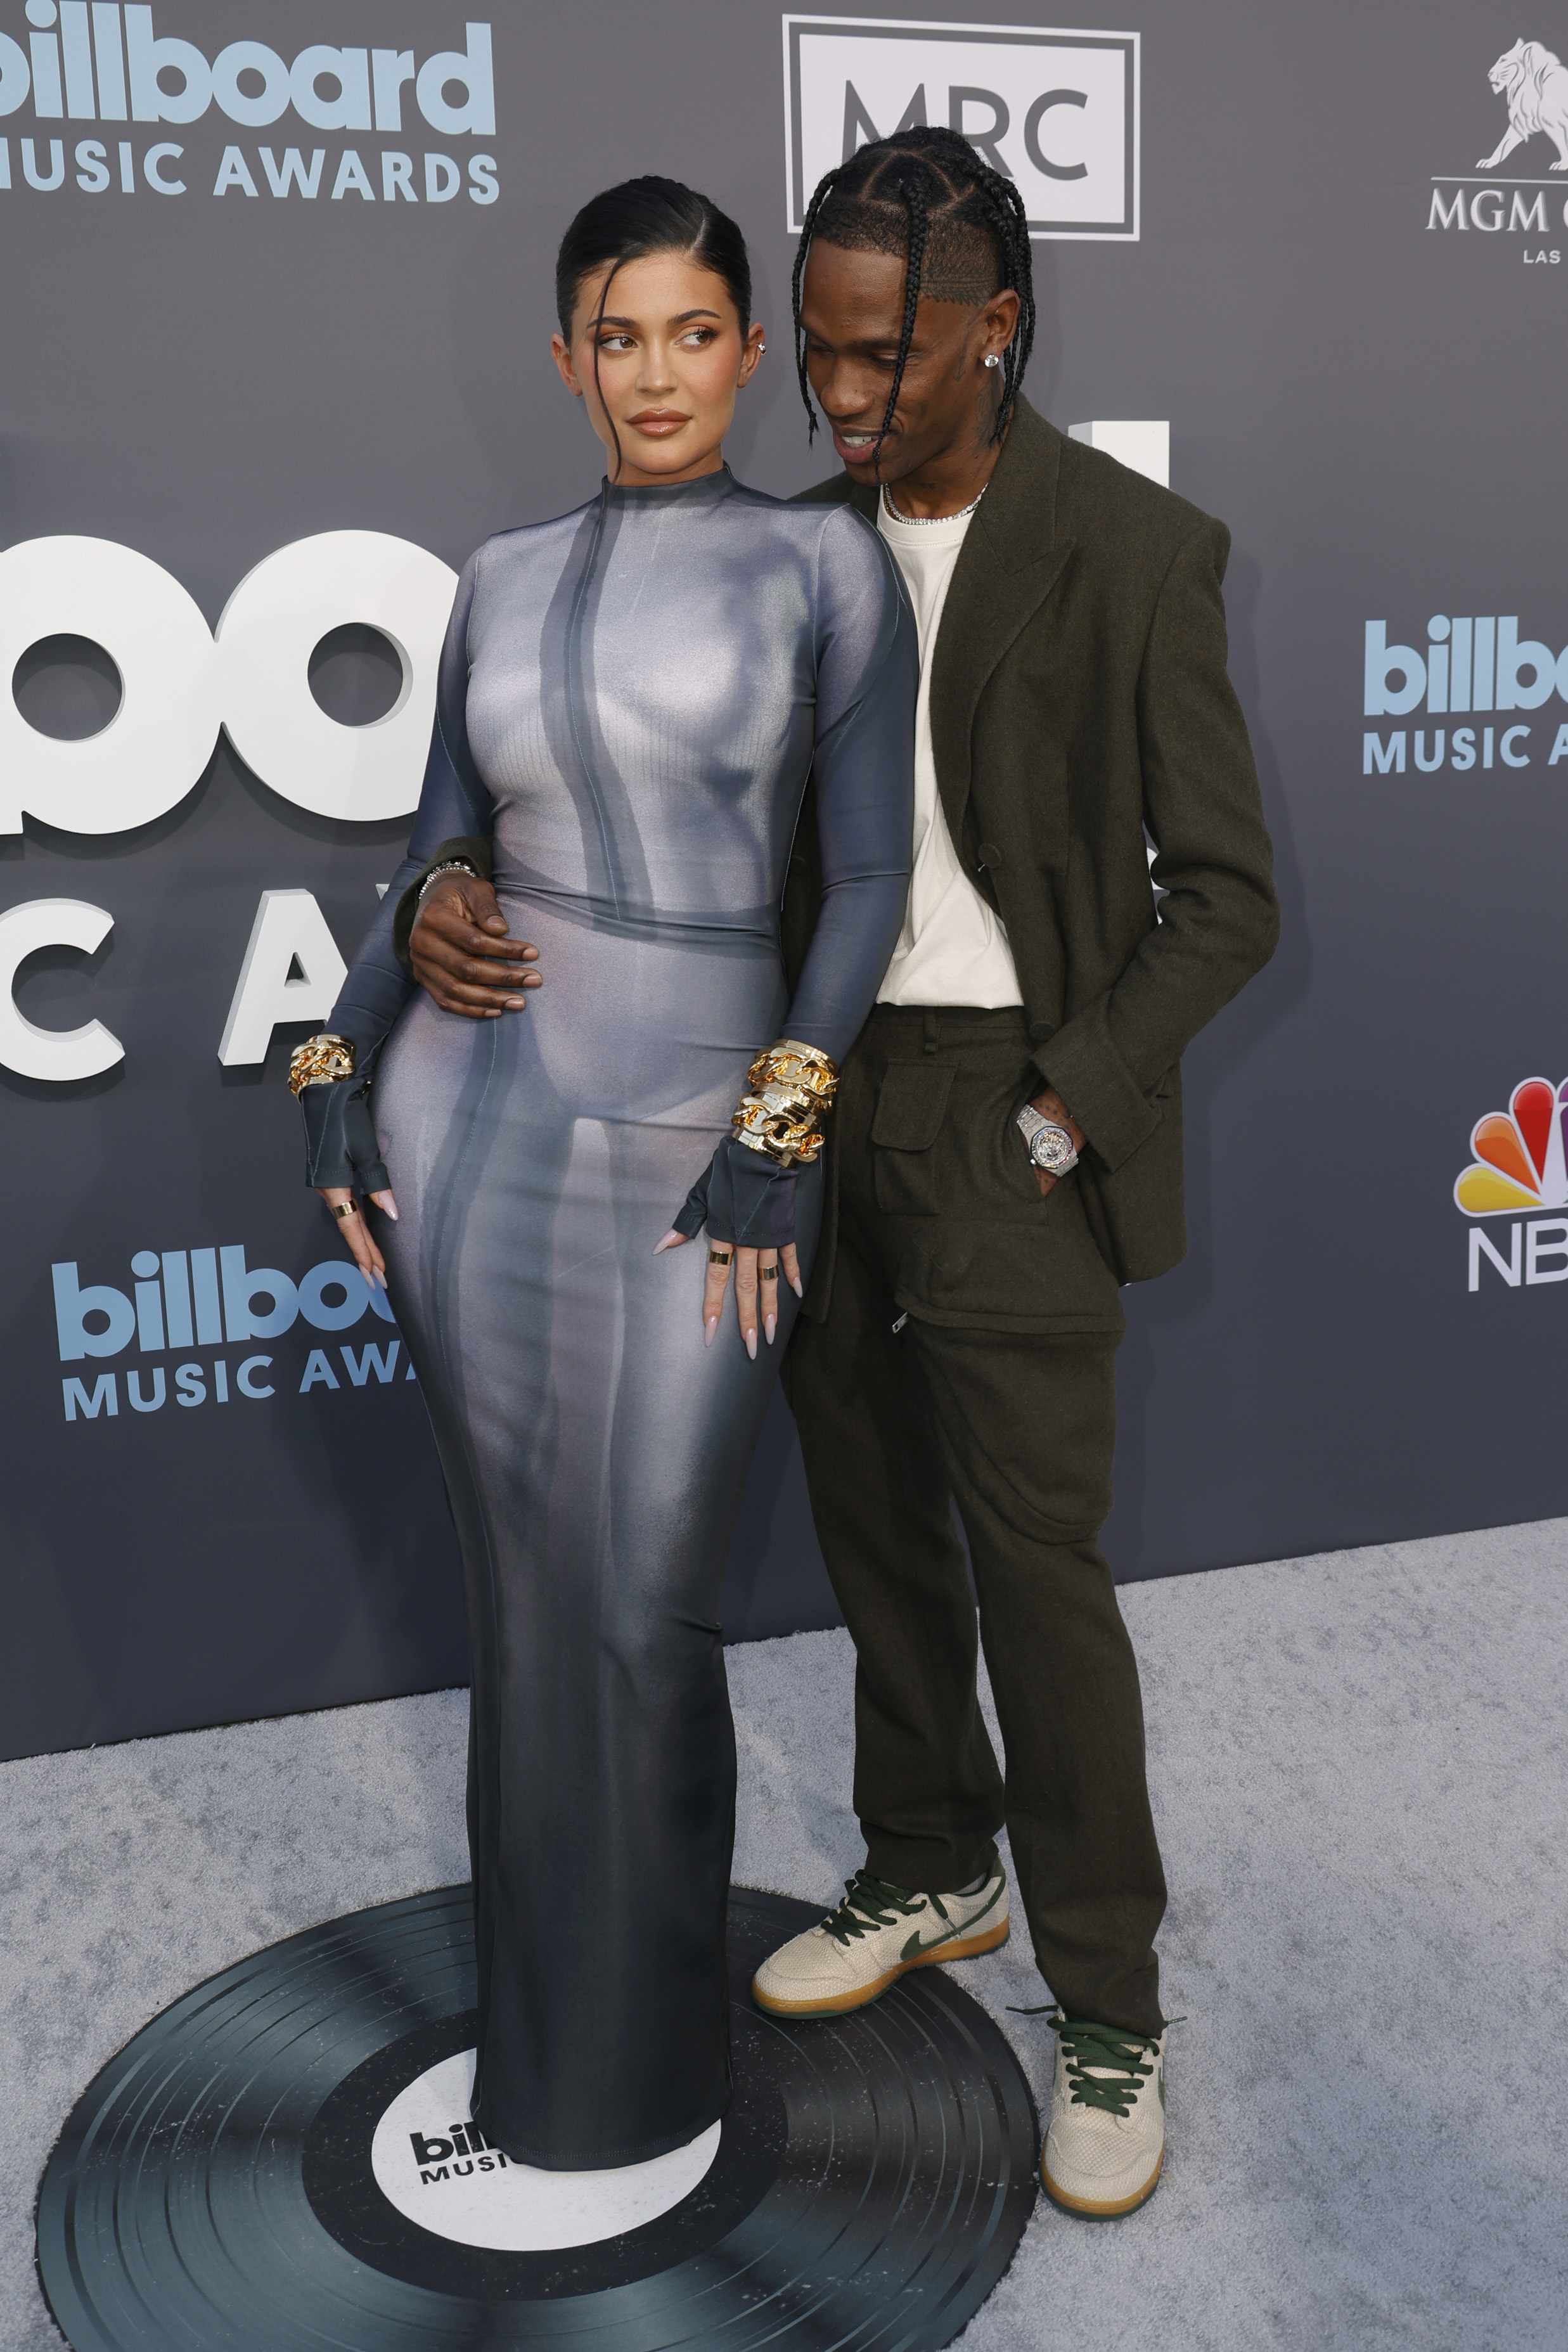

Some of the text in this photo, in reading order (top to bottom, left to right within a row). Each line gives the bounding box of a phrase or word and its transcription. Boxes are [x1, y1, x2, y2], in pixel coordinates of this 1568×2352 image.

[842, 80, 1088, 181] MRC
[0, 137, 499, 205] USIC AWARDS
[1425, 188, 1550, 232] MGM
[1523, 249, 1561, 264] LAS
[1363, 725, 1531, 774] MUSIC
[218, 884, 388, 1066] A
[62, 1340, 417, 1421] MUSIC AW
[409, 2120, 498, 2166] bil
[420, 2153, 507, 2185] MUSI
